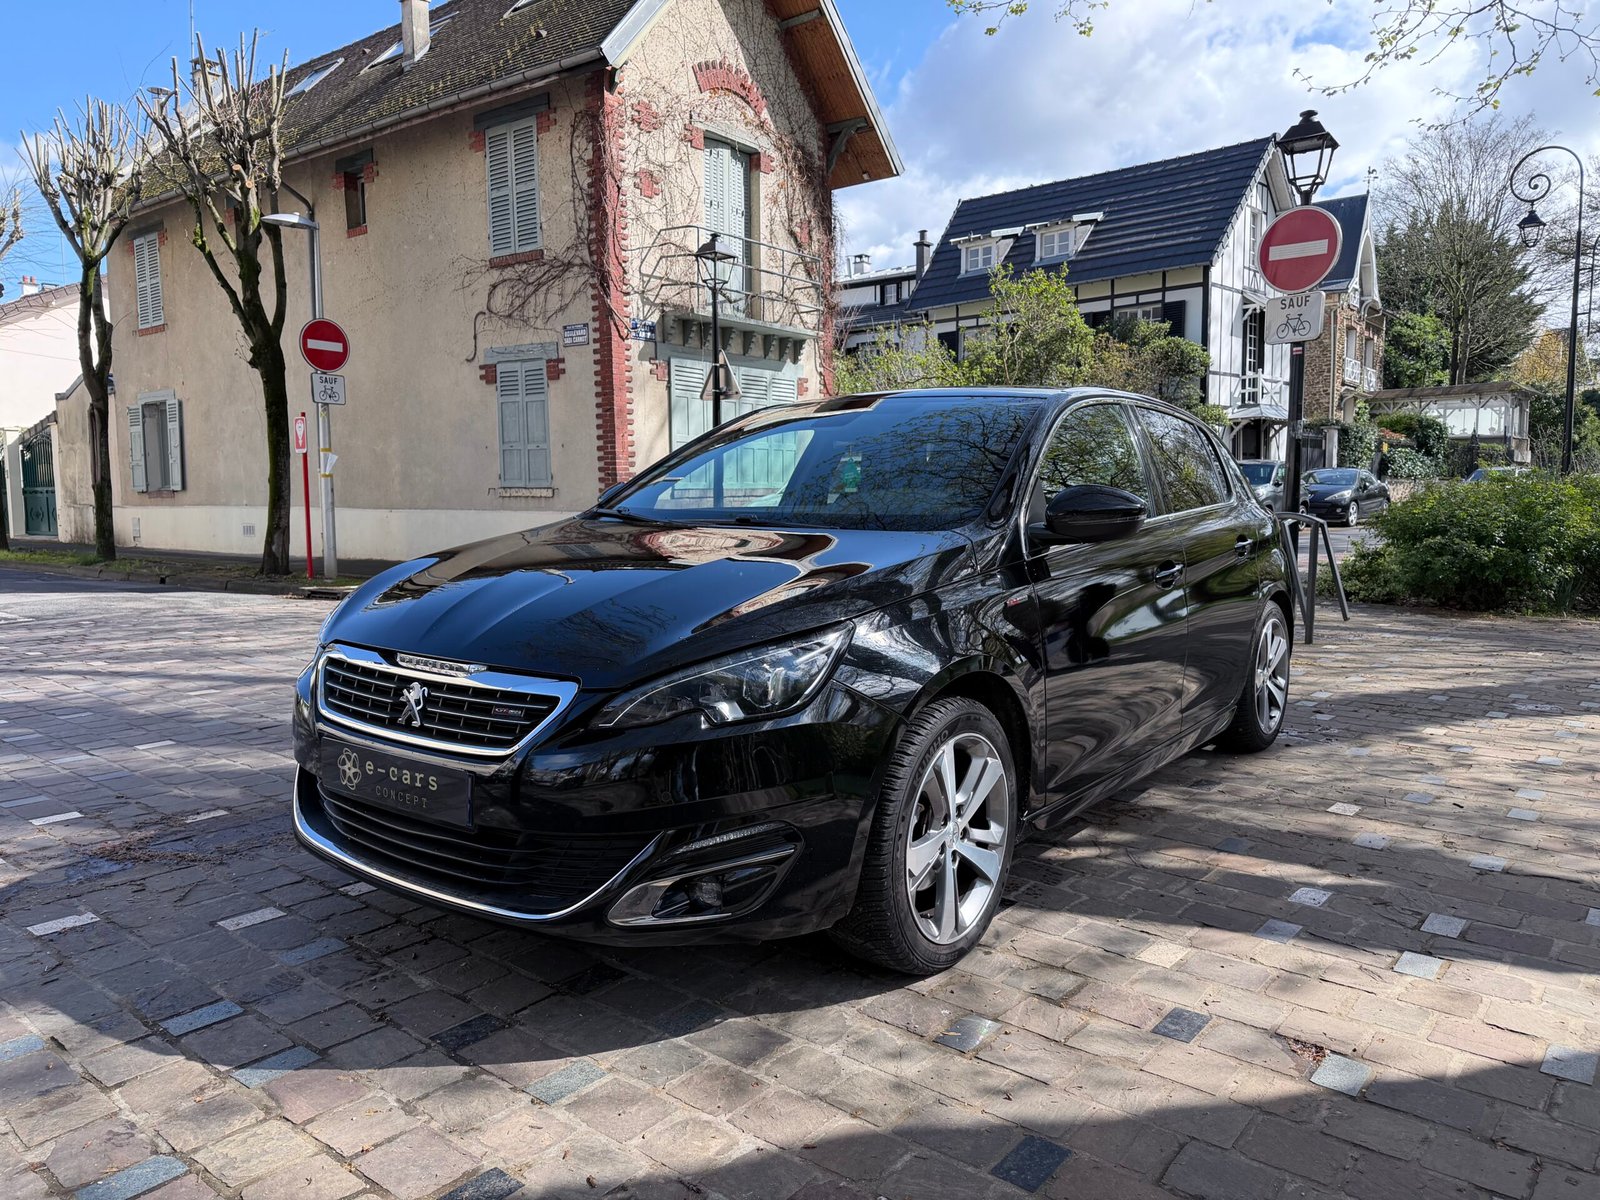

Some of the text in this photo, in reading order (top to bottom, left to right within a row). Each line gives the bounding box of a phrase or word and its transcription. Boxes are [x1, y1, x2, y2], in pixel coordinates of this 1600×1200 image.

[1280, 295, 1311, 310] SAUF
[319, 375, 338, 385] SAUF
[913, 729, 949, 783] KUMHO
[365, 760, 438, 791] e-cars
[375, 785, 429, 808] CONCEPT
